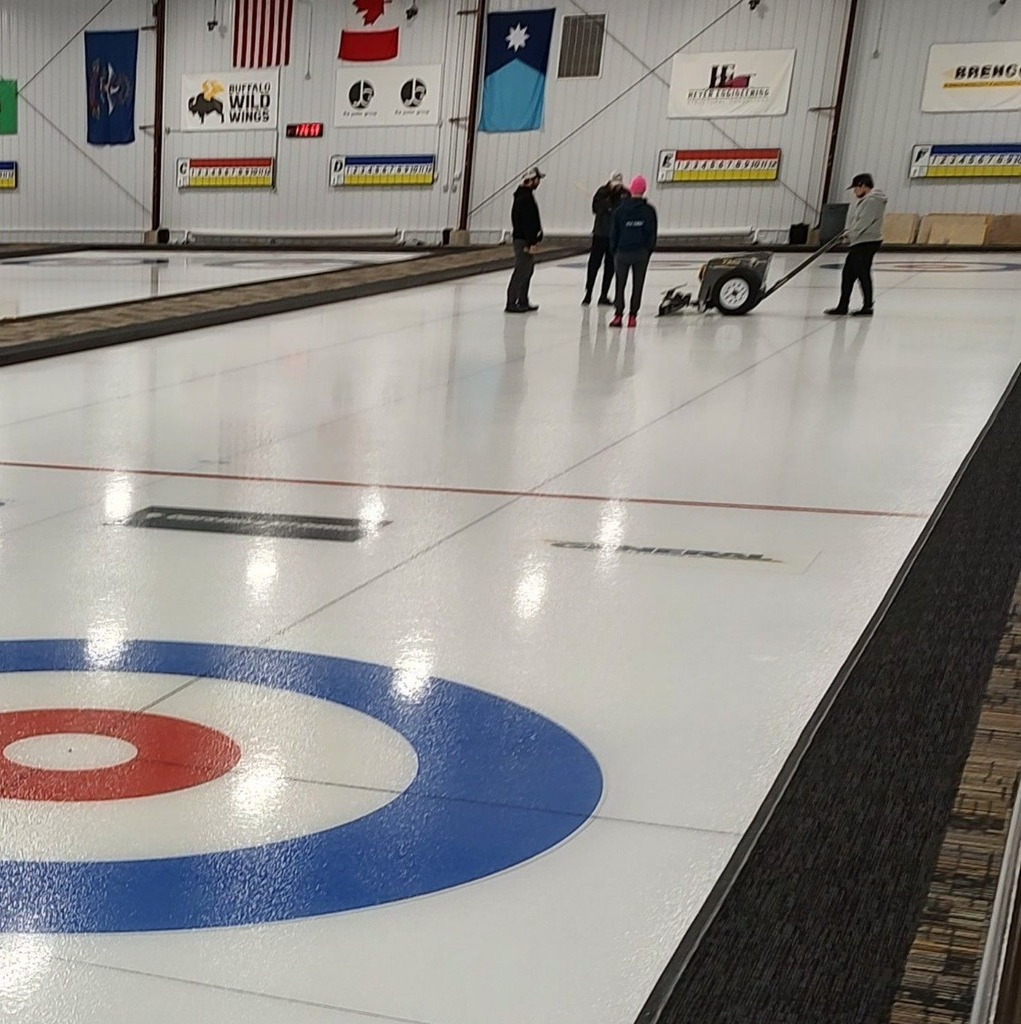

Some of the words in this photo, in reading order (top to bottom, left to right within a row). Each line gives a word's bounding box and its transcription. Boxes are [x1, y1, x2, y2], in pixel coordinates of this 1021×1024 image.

[955, 63, 1021, 79] BRENC
[229, 82, 270, 94] BUFFALO
[715, 89, 769, 98] ENGINEERING
[229, 94, 270, 109] WILD
[229, 110, 269, 123] WINGS
[662, 153, 673, 168] E
[915, 149, 929, 162] F
[179, 162, 187, 175] C
[334, 160, 343, 172] D
